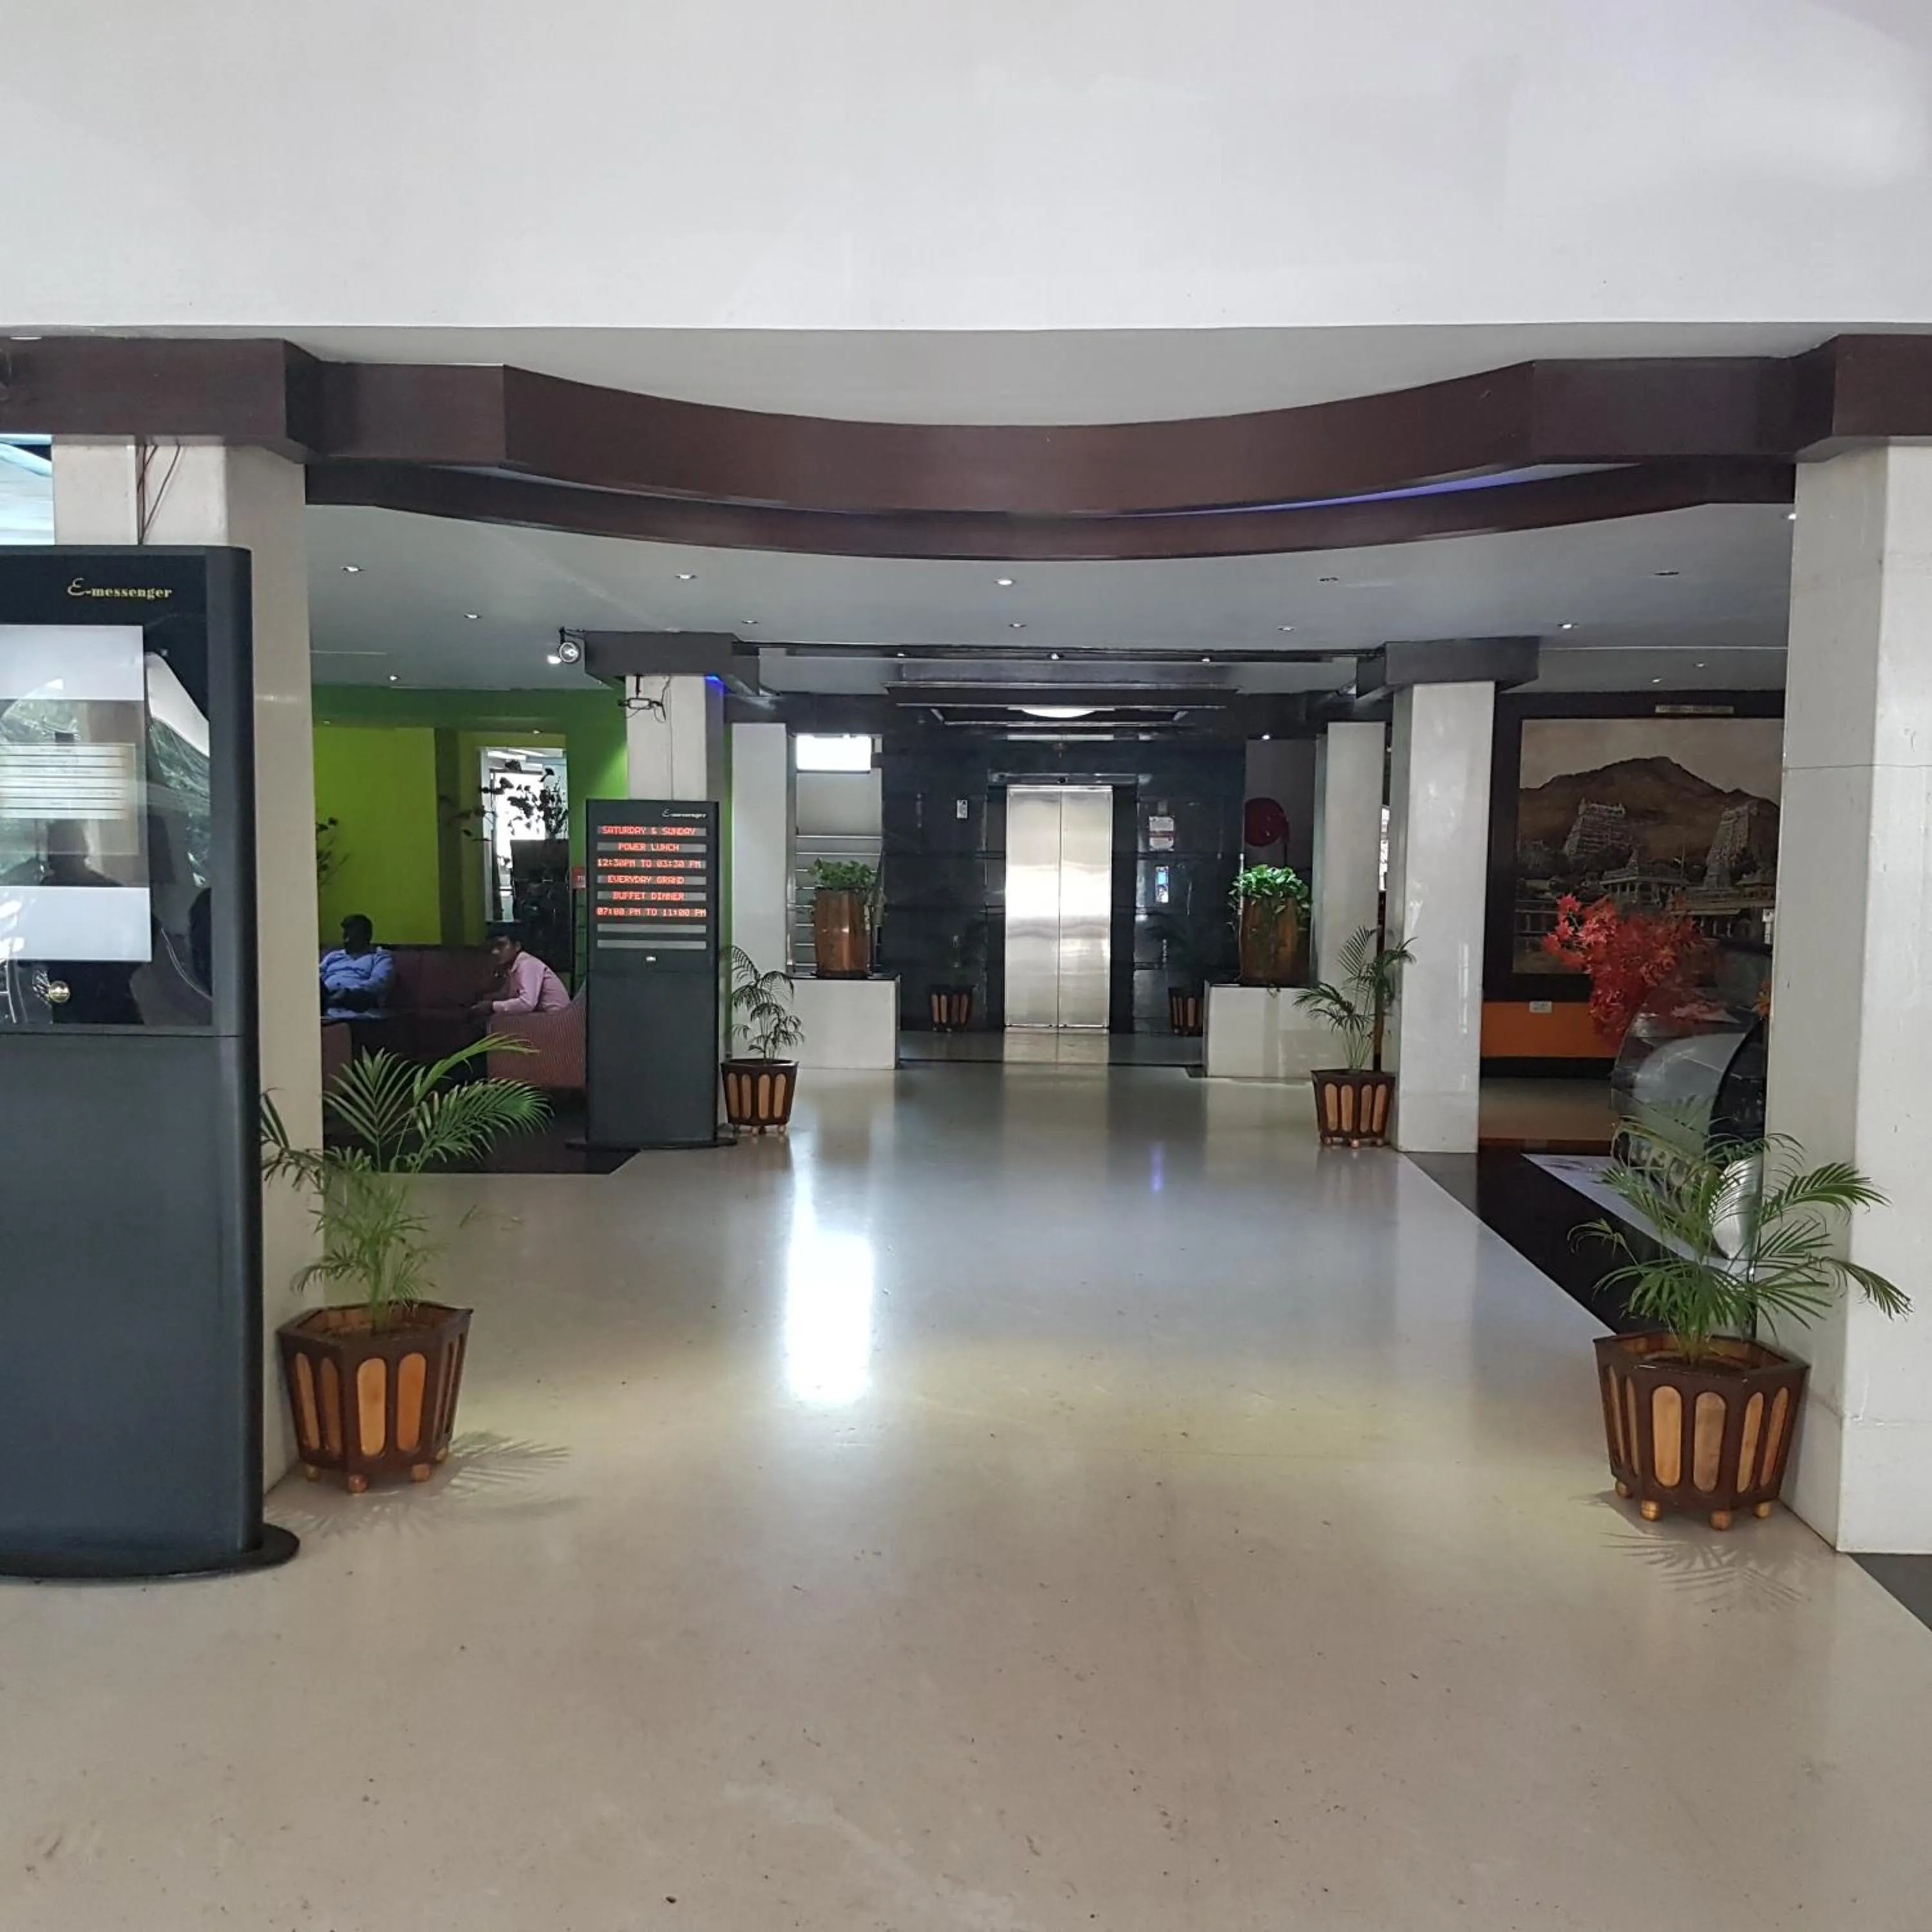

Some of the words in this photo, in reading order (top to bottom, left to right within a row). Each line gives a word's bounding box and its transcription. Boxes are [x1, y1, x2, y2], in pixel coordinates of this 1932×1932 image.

[67, 578, 173, 600] E-messenger
[601, 826, 646, 835] SATURDAY
[661, 827, 696, 835] SUNDAY
[618, 842, 646, 851] POWER
[651, 843, 679, 852] LUNCH
[598, 858, 636, 867] 12:30PM
[690, 860, 701, 868] PM
[607, 875, 650, 884] EVERYDAY
[656, 876, 685, 884] GRAND
[612, 891, 645, 900] BUFFET
[651, 892, 684, 900] DINNER
